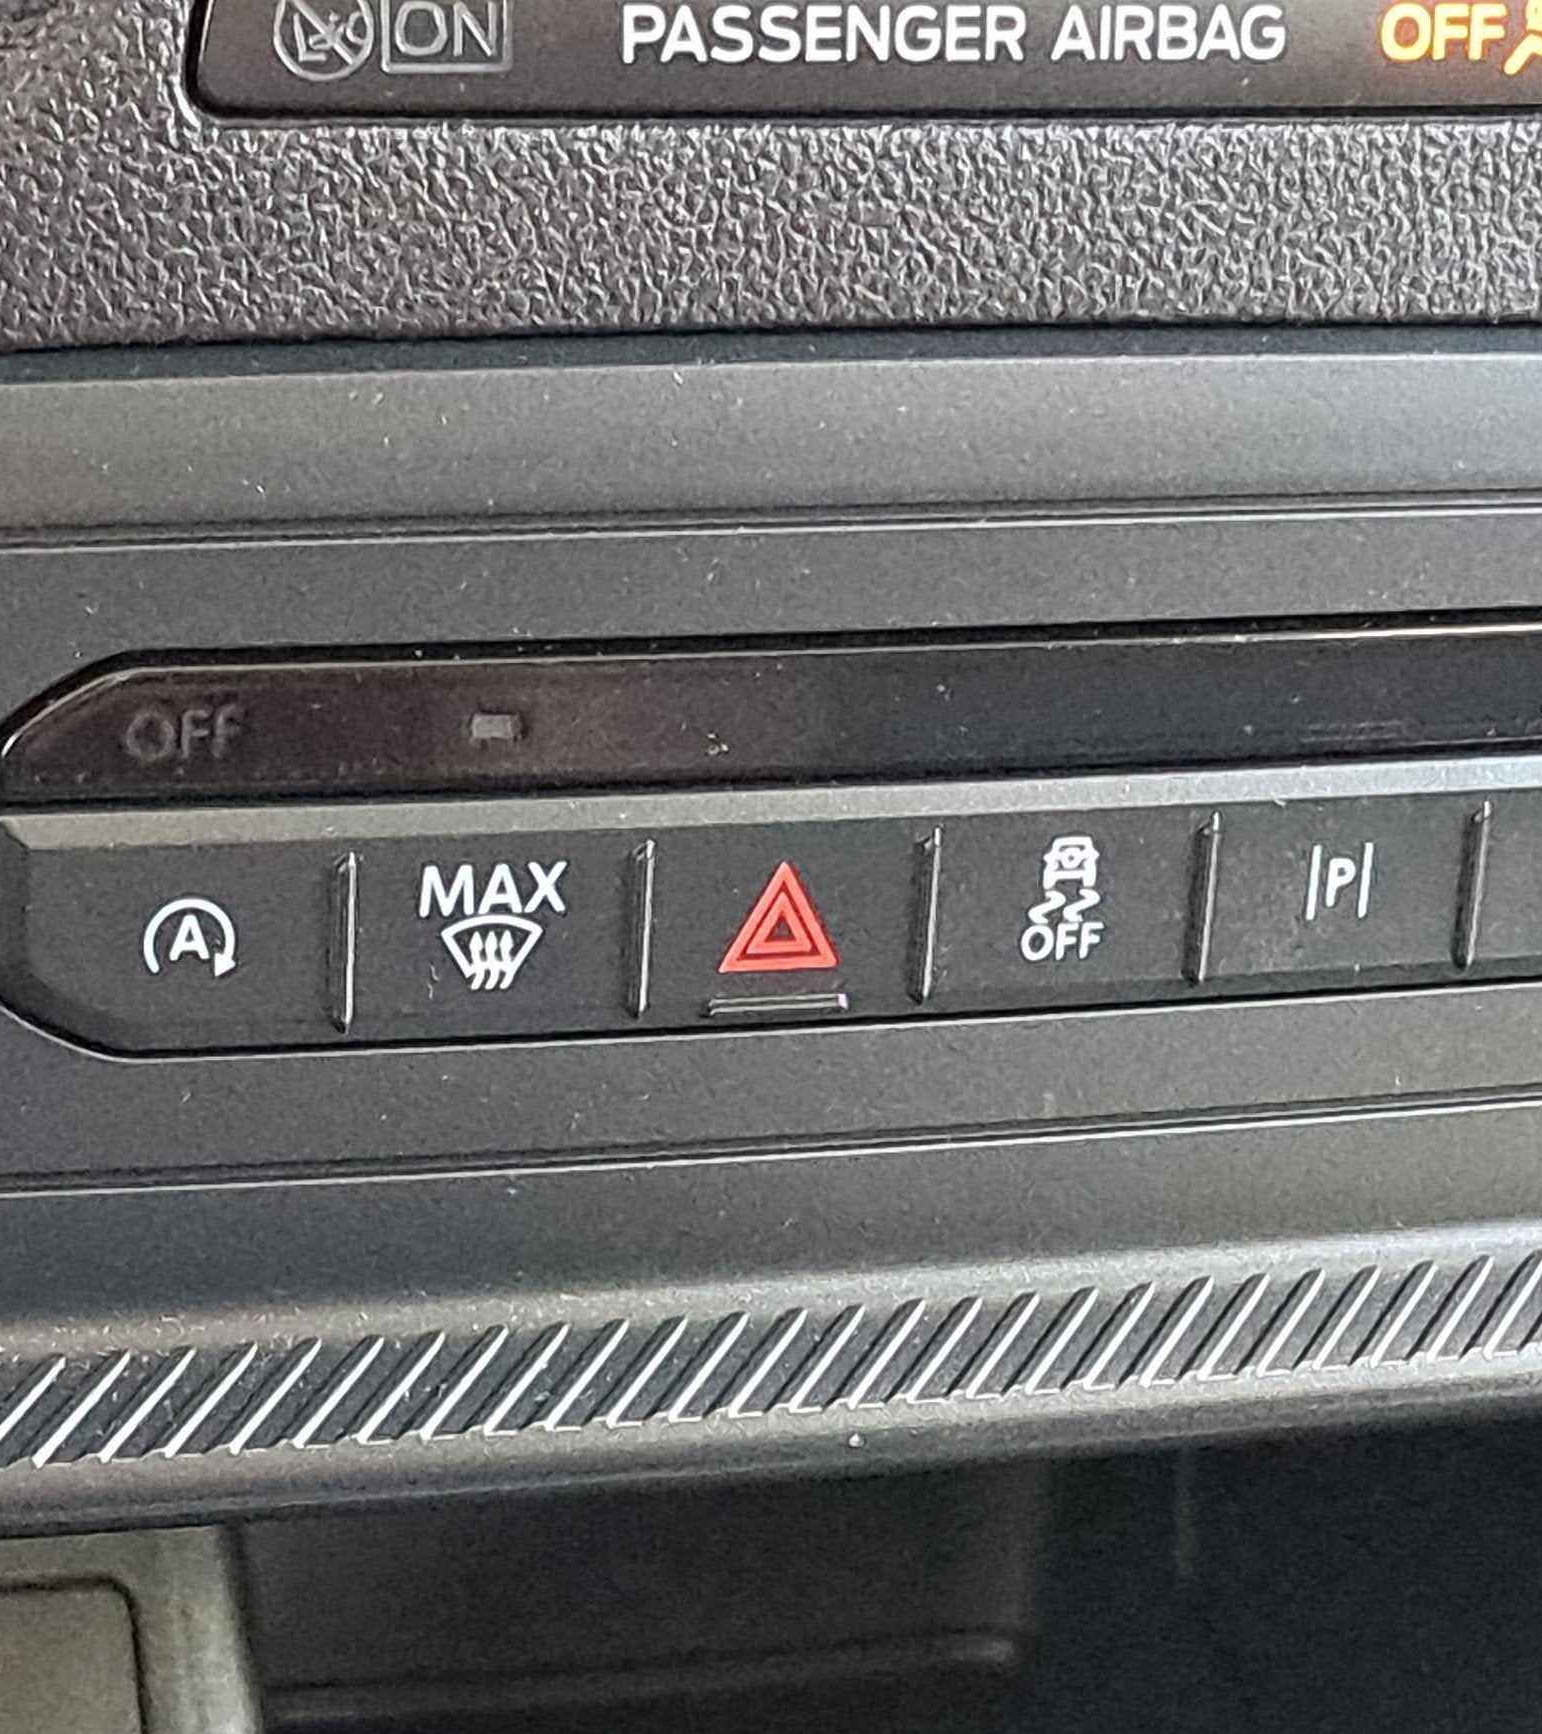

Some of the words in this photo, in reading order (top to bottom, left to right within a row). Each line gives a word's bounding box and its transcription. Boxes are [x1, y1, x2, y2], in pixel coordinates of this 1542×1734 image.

[395, 0, 497, 56] ON
[622, 4, 1025, 63] PASSENGER
[1050, 4, 1286, 61] AIRBAG
[1380, 3, 1508, 61] OFF
[124, 705, 244, 762] OFF
[418, 861, 568, 919] MAX
[1020, 922, 1104, 961] OFF
